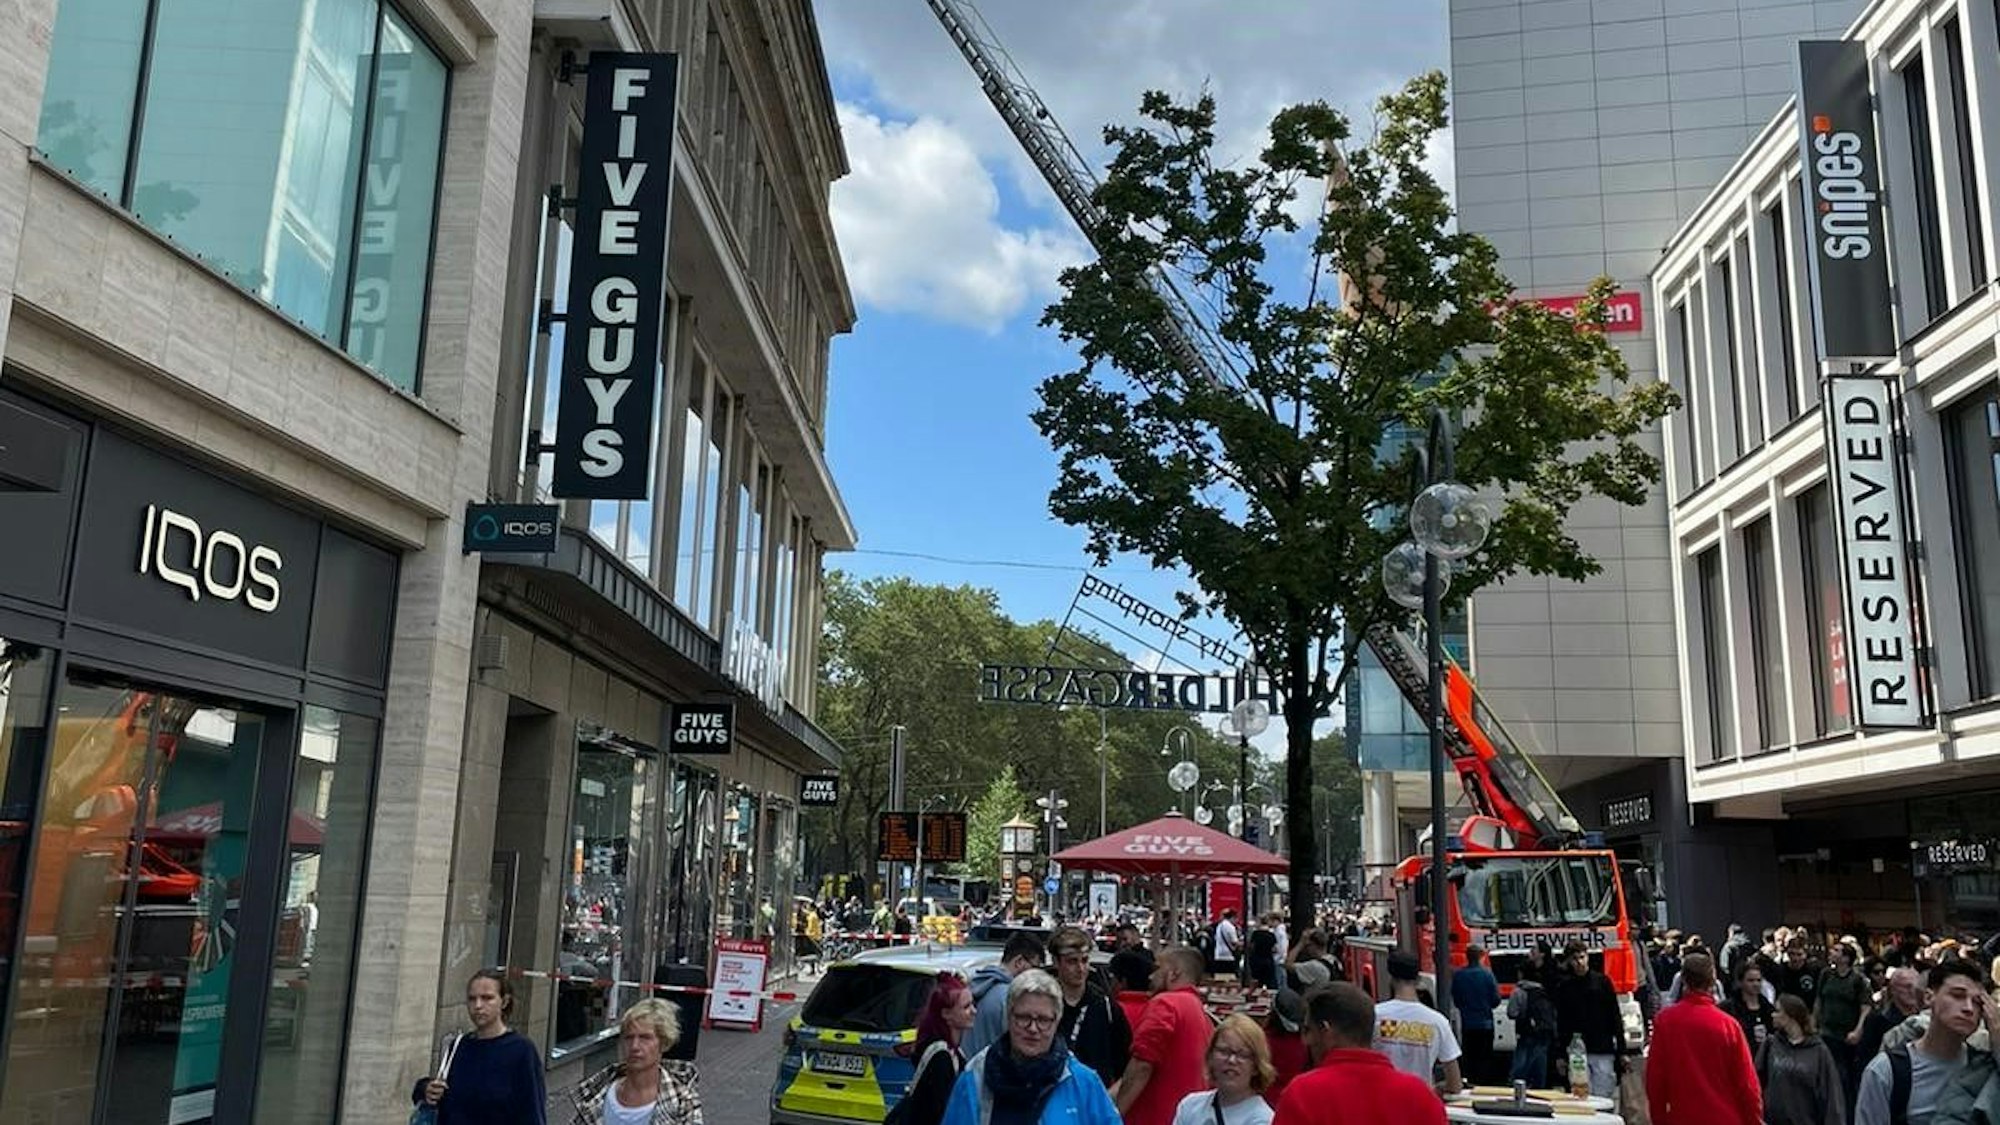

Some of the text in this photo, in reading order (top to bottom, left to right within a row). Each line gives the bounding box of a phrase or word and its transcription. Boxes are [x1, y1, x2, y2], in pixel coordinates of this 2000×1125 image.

[1813, 132, 1876, 260] snipes
[579, 68, 650, 478] FIVE GUYS
[504, 522, 553, 537] IQOS
[140, 504, 283, 613] IQOS
[1844, 396, 1907, 706] RESERVED
[680, 713, 724, 728] FIVE
[673, 729, 729, 744] GUYS
[805, 780, 835, 792] FIVE
[802, 790, 837, 801] GUYS
[1608, 797, 1651, 826] RESERVED
[1134, 834, 1205, 846] FIVE
[1123, 843, 1214, 856] GUYS
[1927, 843, 1986, 863] RESERVED
